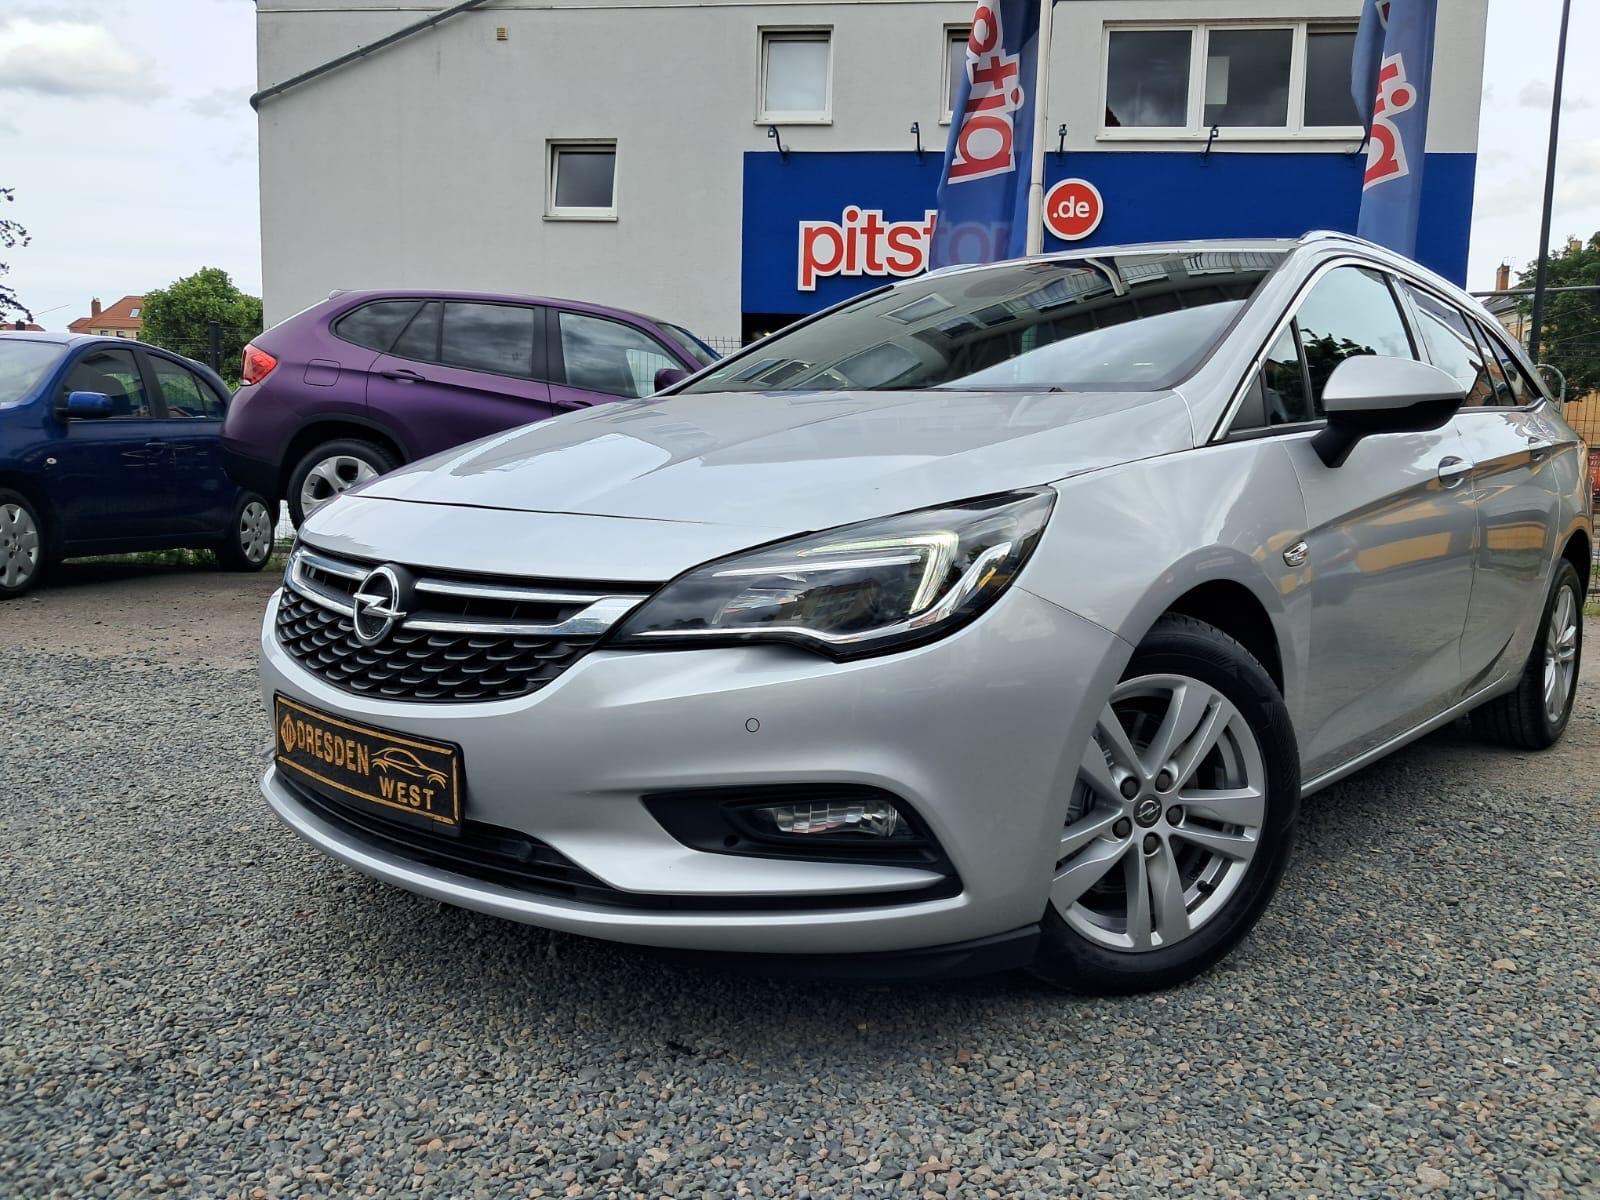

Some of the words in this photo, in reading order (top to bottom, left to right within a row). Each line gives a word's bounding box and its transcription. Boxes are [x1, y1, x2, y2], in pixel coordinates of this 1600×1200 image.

[1052, 195, 1091, 219] .de
[296, 720, 370, 776] DRESDEN
[379, 775, 435, 810] WEST
